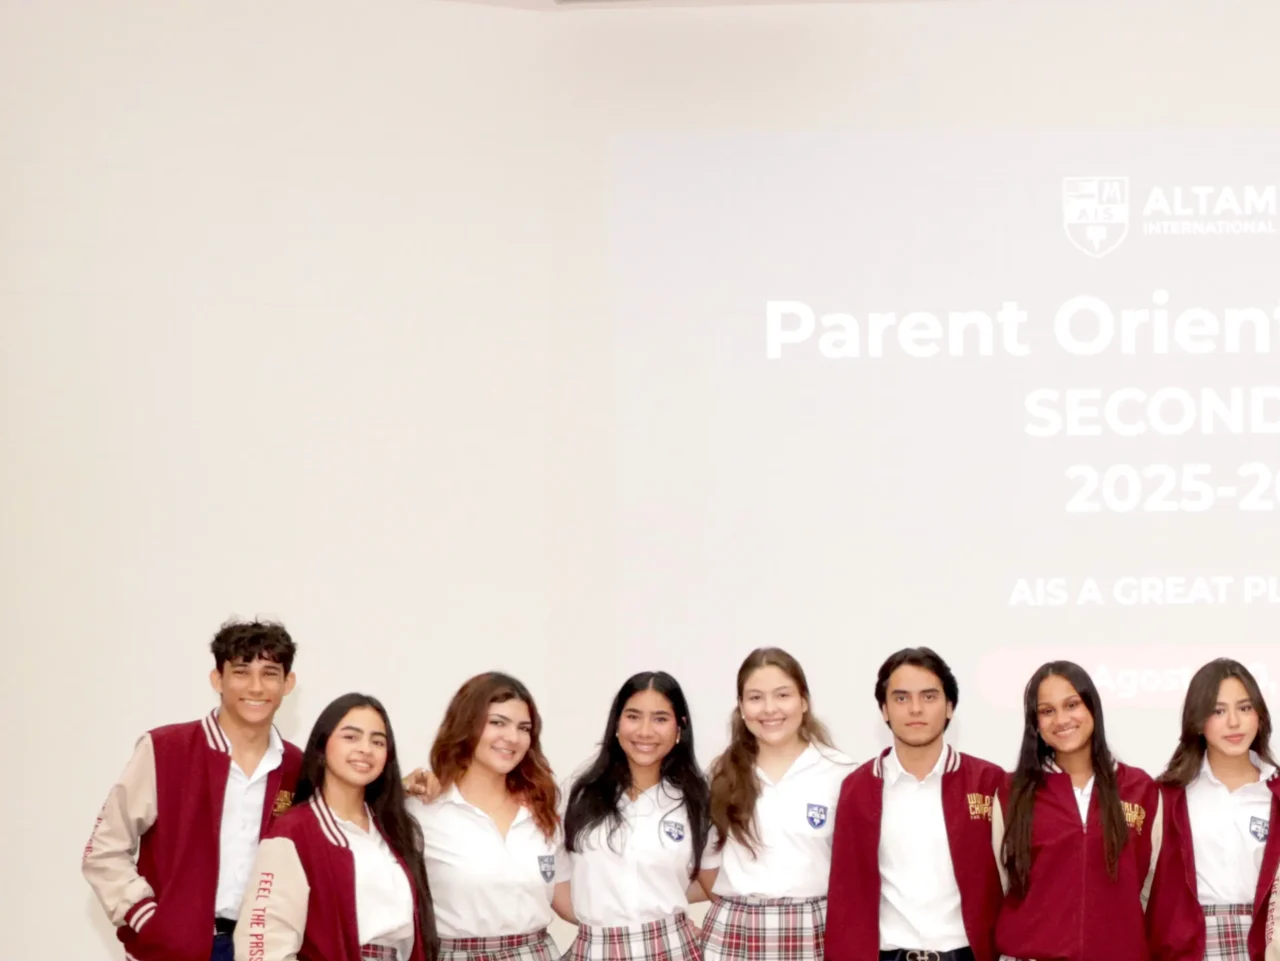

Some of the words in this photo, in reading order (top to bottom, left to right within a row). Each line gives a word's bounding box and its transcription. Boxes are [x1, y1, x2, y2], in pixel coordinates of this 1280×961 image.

[1143, 220, 1276, 235] INTERNATIONAL
[765, 301, 1031, 360] Parent
[1008, 577, 1069, 608] AIS
[1076, 577, 1105, 606] A
[1112, 575, 1235, 606] GREAT
[256, 872, 274, 901] FEEL
[250, 907, 267, 928] THE
